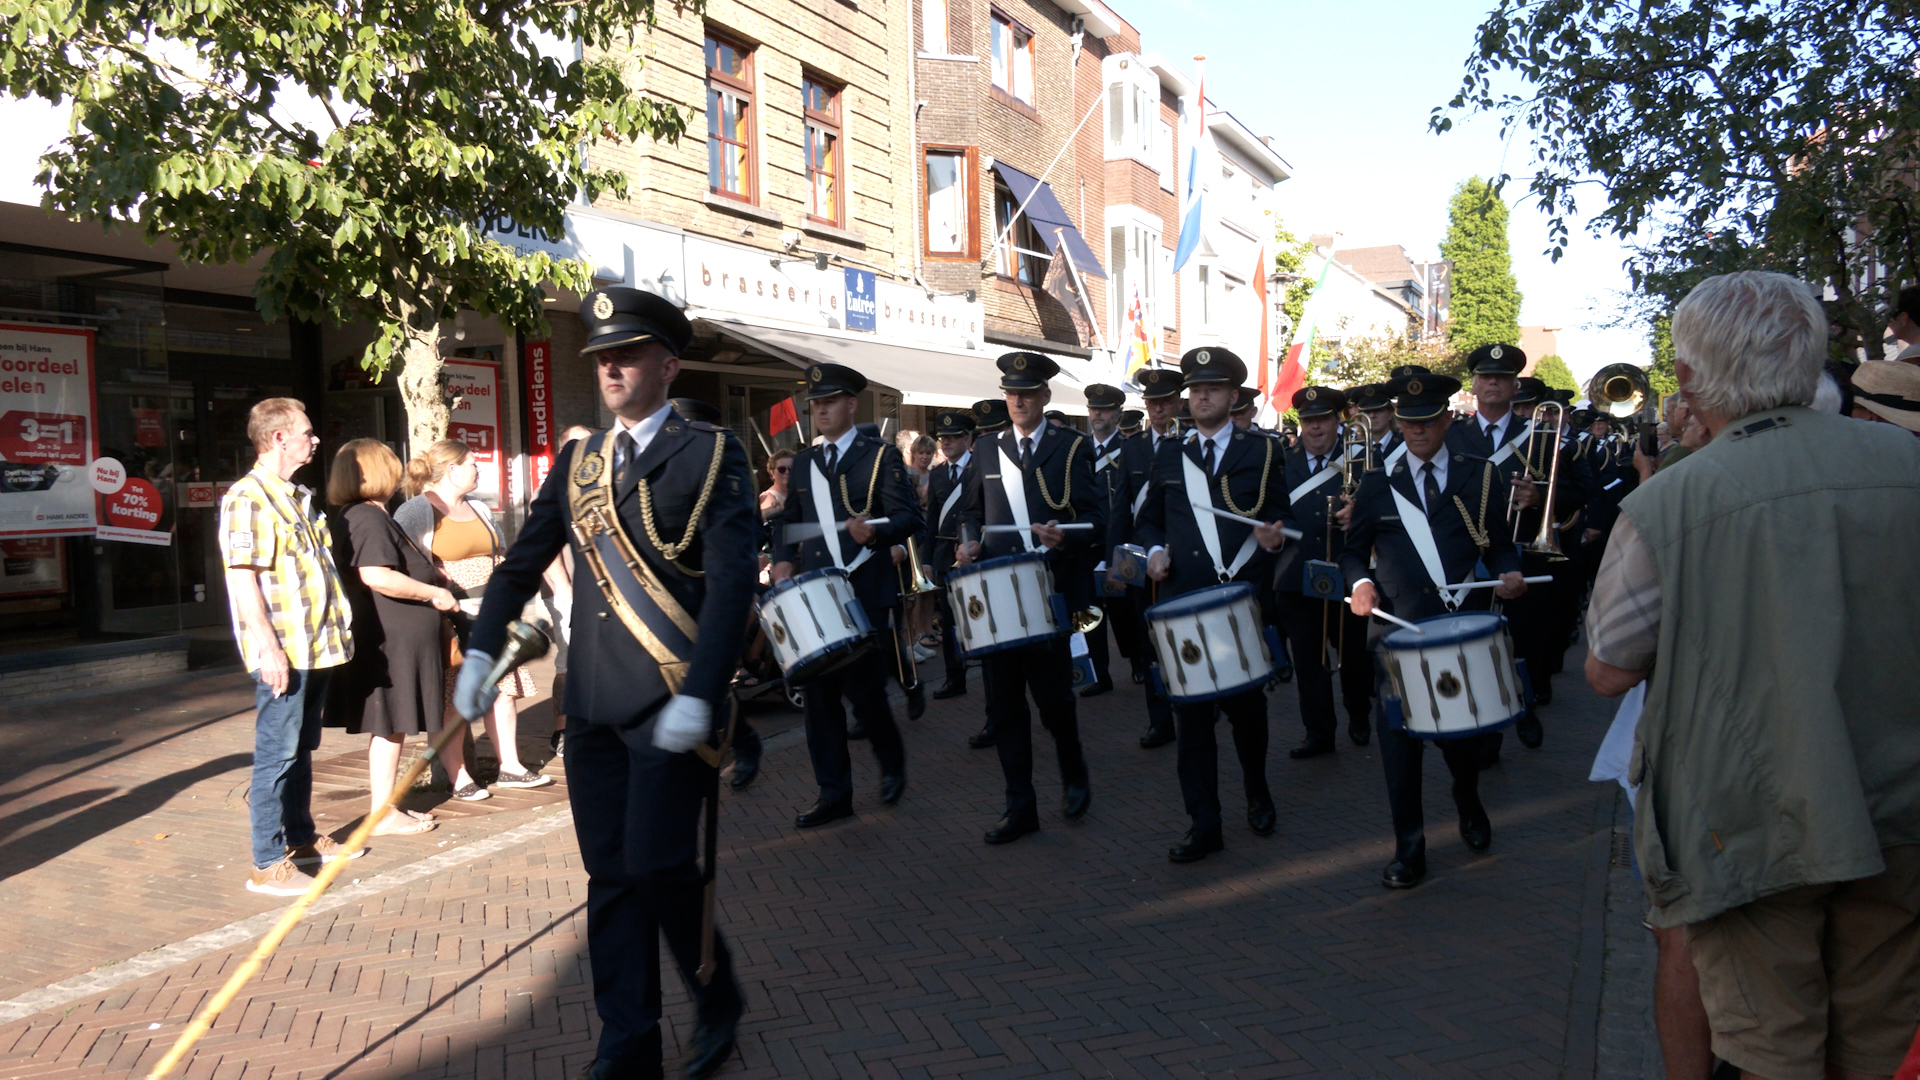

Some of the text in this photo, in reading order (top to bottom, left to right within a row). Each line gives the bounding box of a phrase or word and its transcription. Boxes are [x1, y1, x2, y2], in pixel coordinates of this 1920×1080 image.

[702, 262, 837, 310] brasserie
[846, 290, 875, 315] Entrée
[885, 300, 975, 333] brasserie
[16, 344, 27, 353] bij
[29, 345, 52, 353] Hans
[0, 356, 79, 375] oordeel
[448, 383, 490, 396] oordeel
[532, 347, 548, 446] audiciens
[96, 475, 117, 484] Hans
[109, 469, 120, 478] bij
[122, 493, 149, 507] 70%
[112, 503, 158, 522] korting
